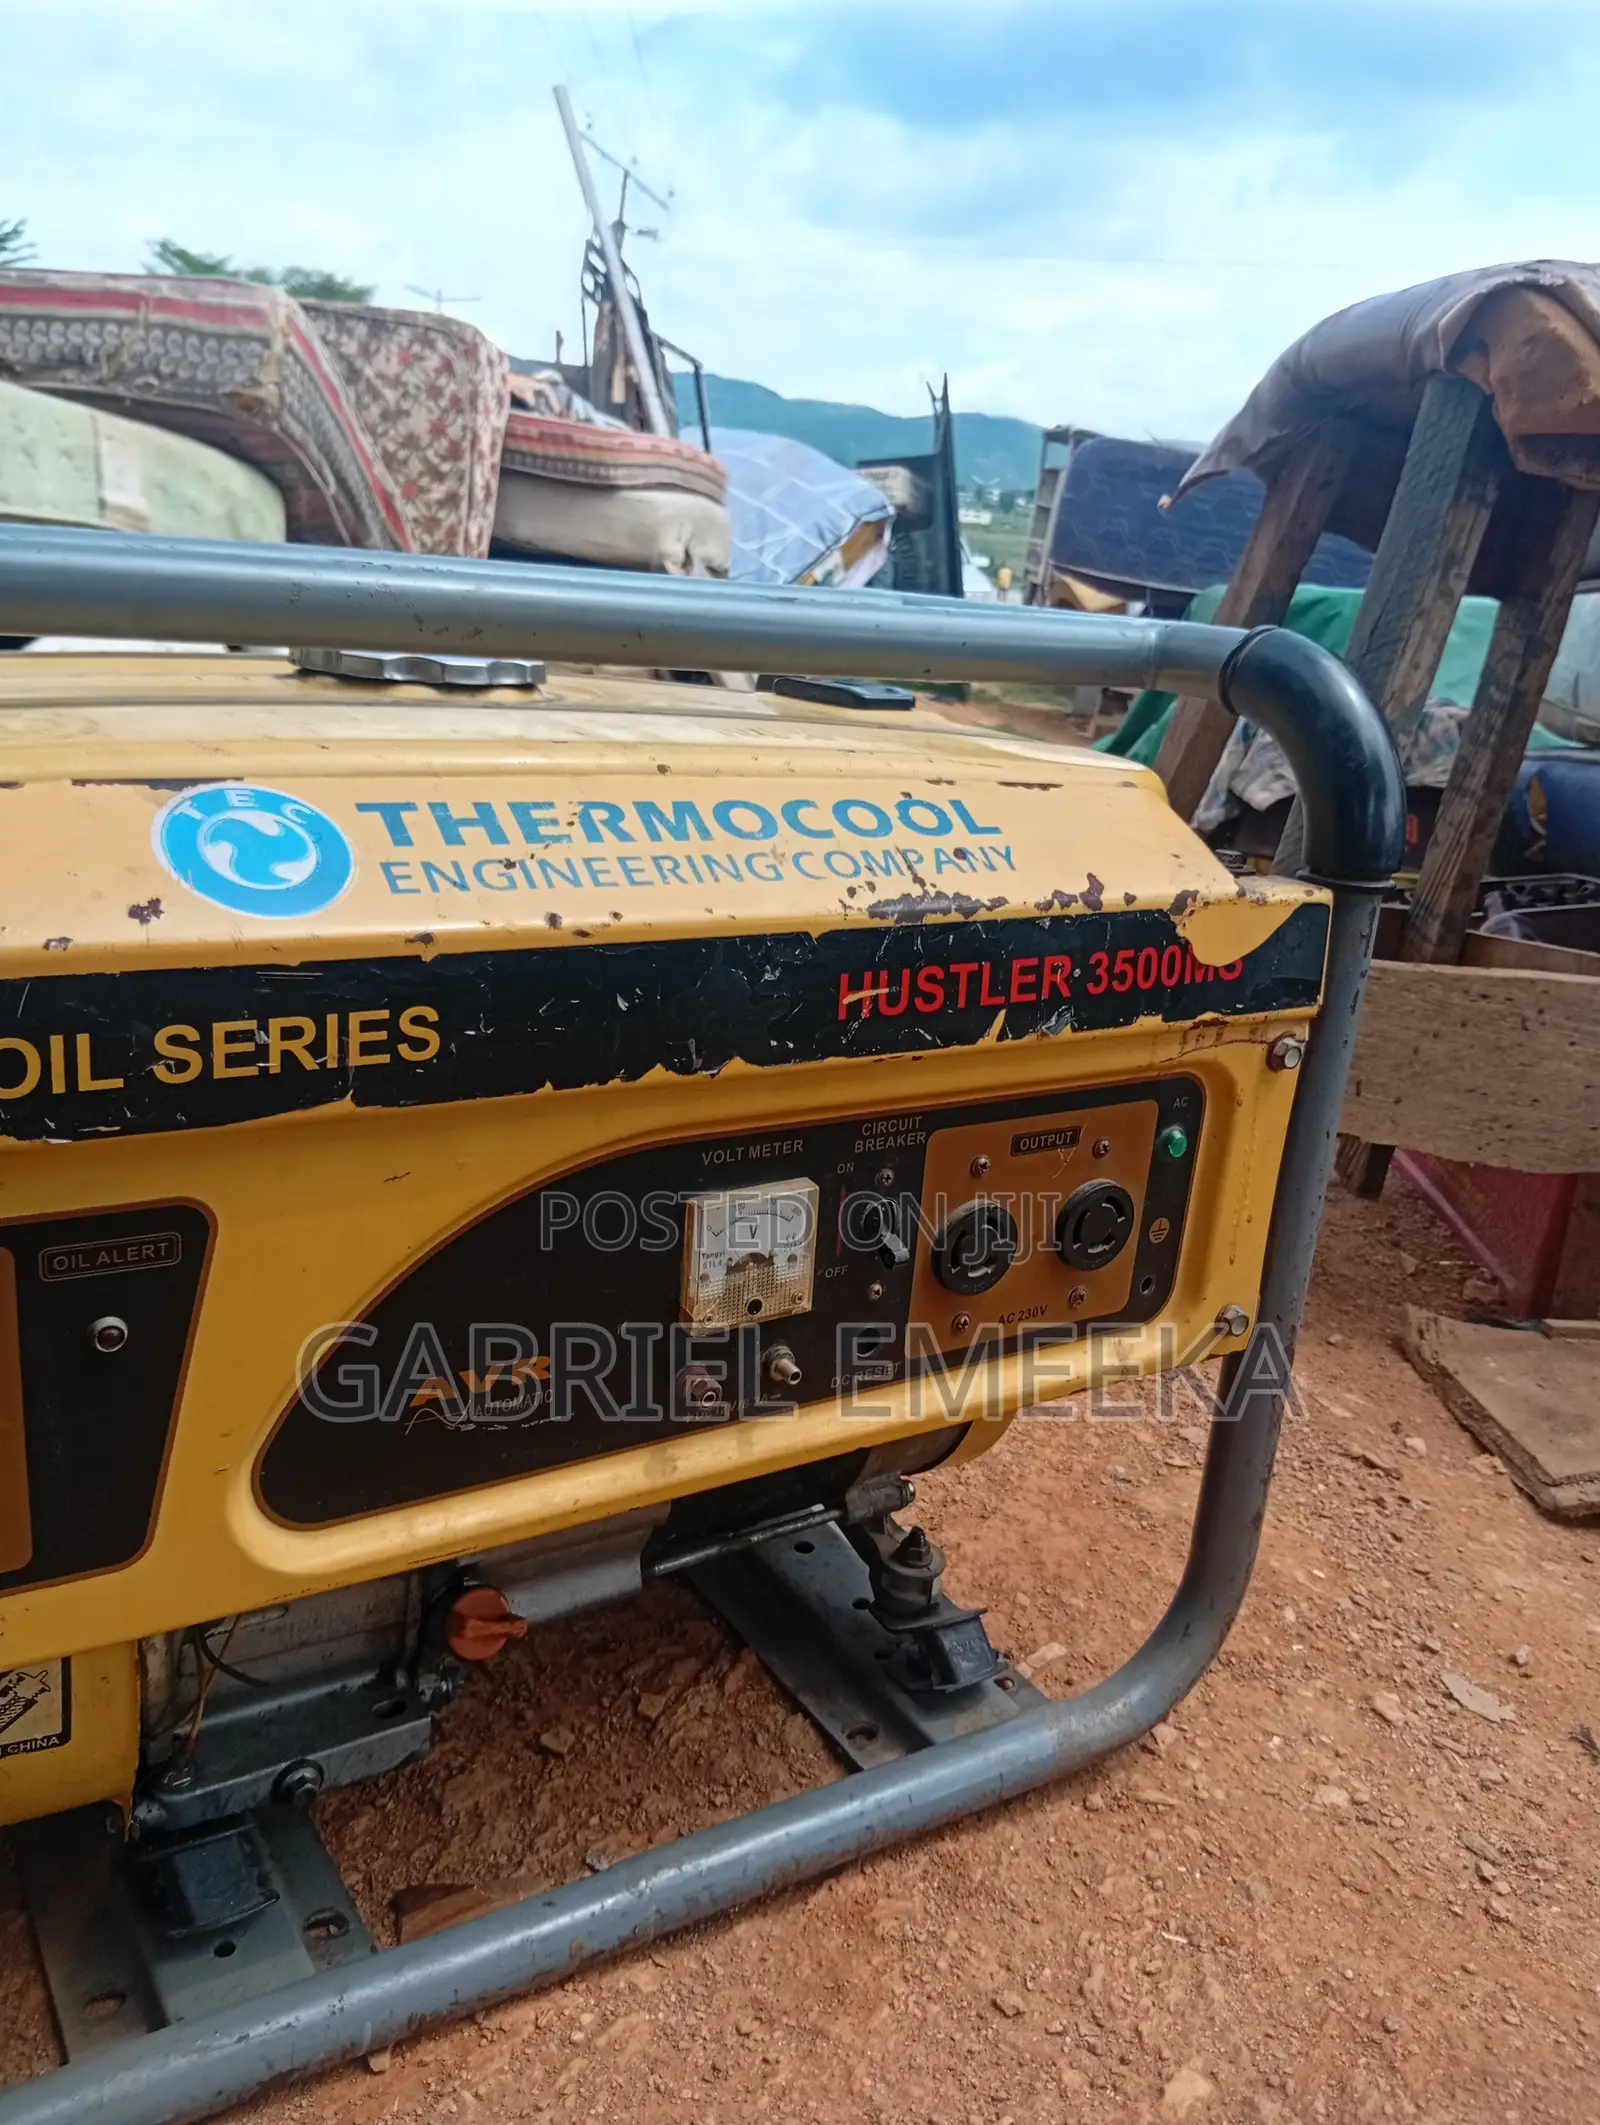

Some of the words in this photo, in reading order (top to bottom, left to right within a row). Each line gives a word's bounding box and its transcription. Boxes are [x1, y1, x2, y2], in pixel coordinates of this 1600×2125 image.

[354, 798, 1003, 847] THERMOCOOL
[378, 851, 785, 895] ENGINEERING
[791, 844, 1017, 880] COMPANY
[837, 954, 1072, 1021] HUSTLER
[0, 1033, 124, 1100] OIL
[153, 1005, 441, 1085] SERIES
[1172, 1096, 1189, 1108] AC
[862, 1115, 923, 1137] CIRCUIT
[702, 1147, 744, 1166] VOLT
[748, 1139, 804, 1160] METER
[854, 1131, 927, 1154] BREAKER
[1019, 1131, 1074, 1151] OUTPUT
[837, 1161, 855, 1174] ON
[749, 1224, 758, 1239] V
[53, 1254, 91, 1271] OIL
[96, 1241, 170, 1266] ALERT
[825, 1264, 849, 1278] OFF
[997, 1311, 1016, 1325] AC
[1017, 1304, 1049, 1322] 230V
[409, 1355, 553, 1408] AVR
[830, 1373, 850, 1388] DC
[854, 1361, 905, 1383] RESET
[474, 1389, 554, 1418] AUTOMATIC
[7, 1735, 60, 1754] CHINA
